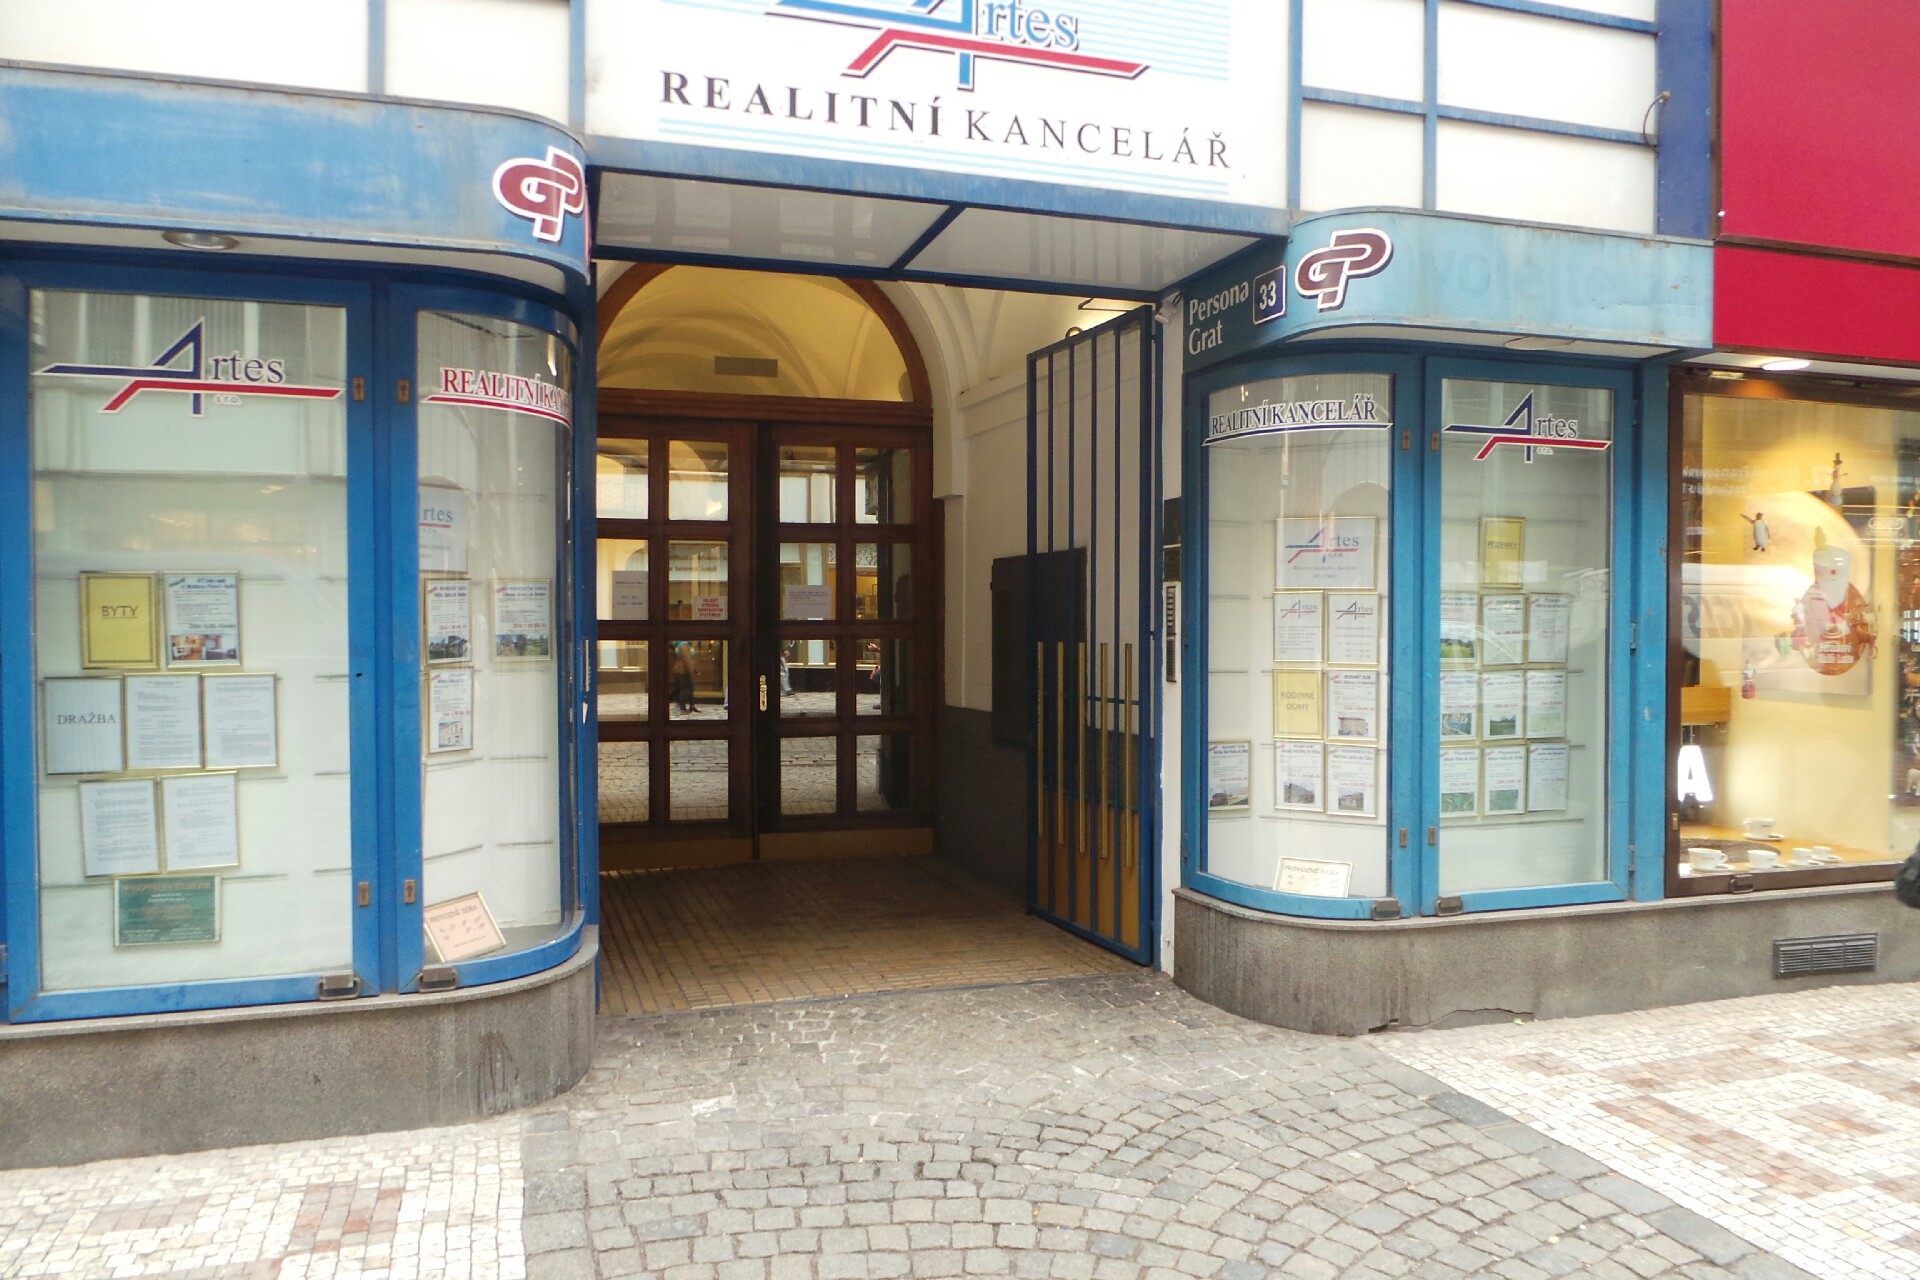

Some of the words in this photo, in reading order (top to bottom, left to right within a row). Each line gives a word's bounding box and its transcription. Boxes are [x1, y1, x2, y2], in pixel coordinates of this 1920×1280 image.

[659, 70, 943, 137] REALITNÍ
[965, 108, 1232, 169] KANCELÁŘ
[1188, 281, 1250, 326] Persona
[1258, 280, 1277, 311] 33
[1188, 319, 1224, 355] Grat
[441, 367, 542, 407] REALITNÍ
[1211, 399, 1269, 436] REALITNÍ
[1271, 393, 1378, 426] KANCELÁŘ
[101, 605, 139, 617] BYTY
[57, 713, 116, 726] DRAŽBA
[1677, 745, 1713, 801] A
